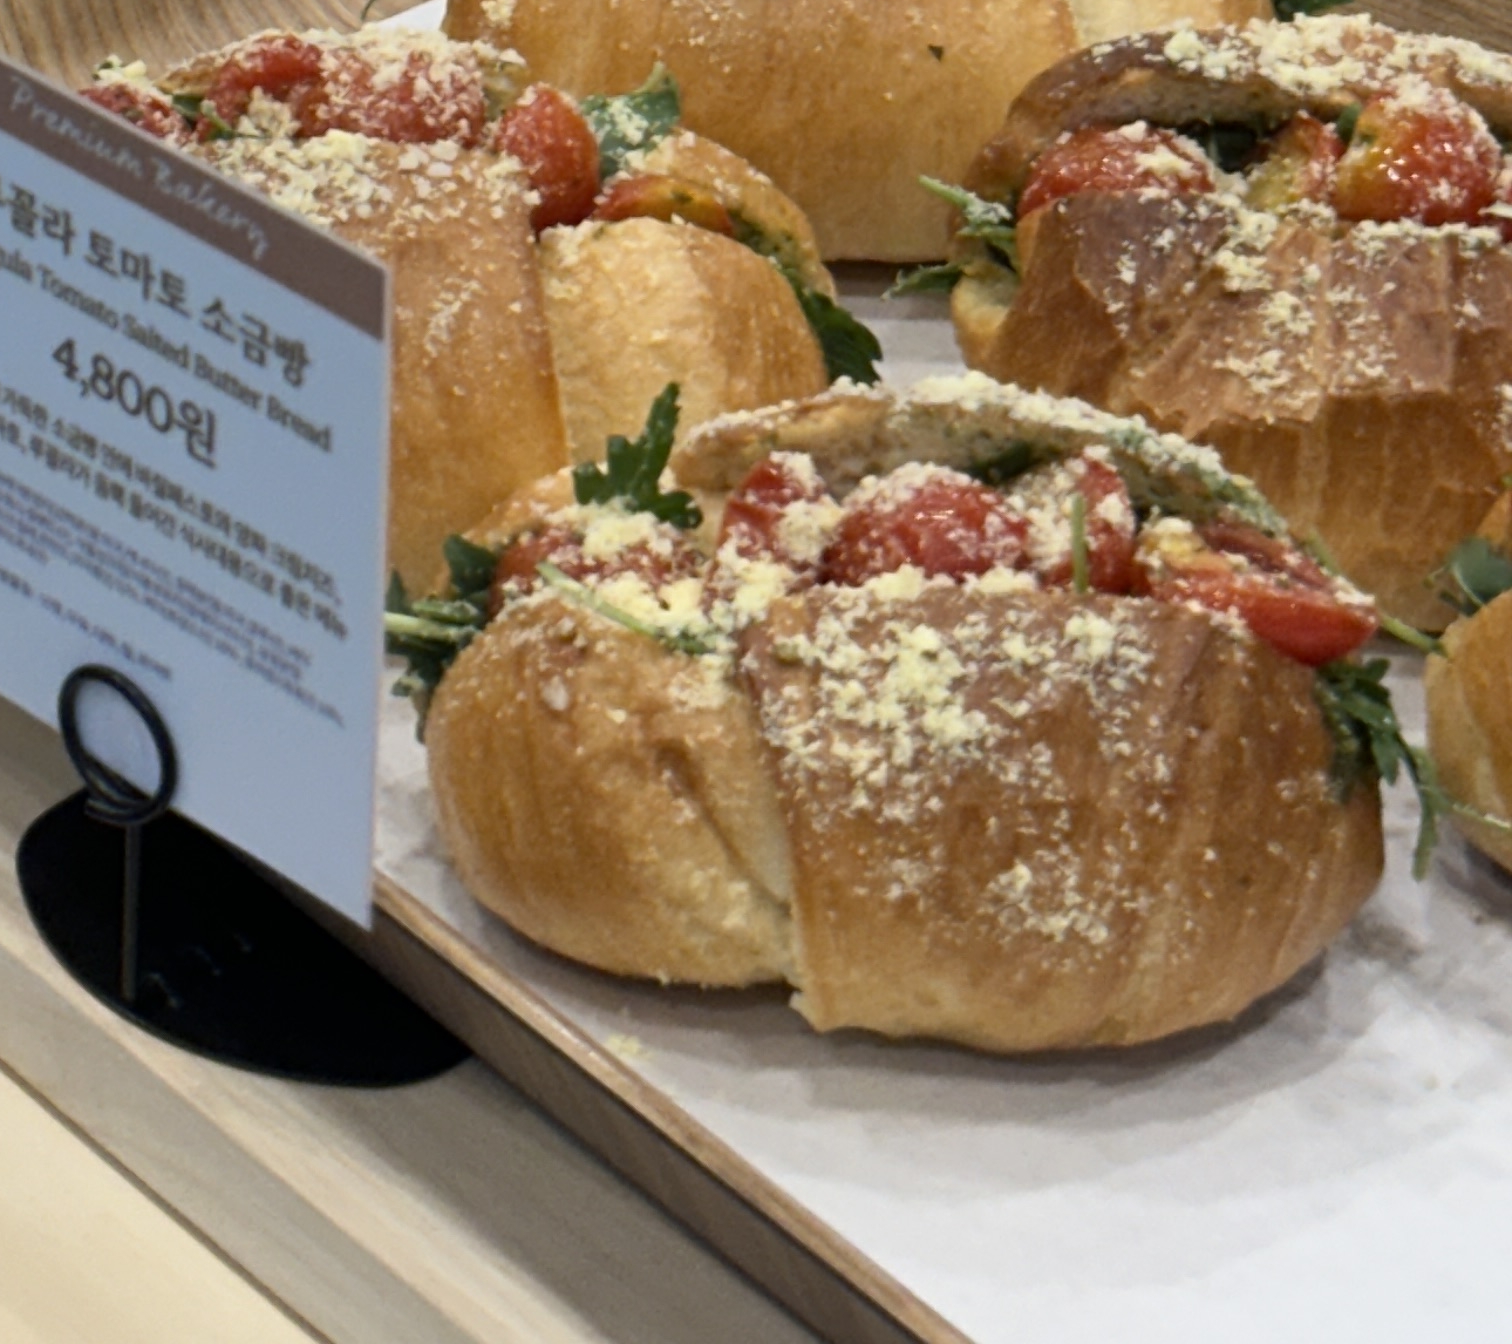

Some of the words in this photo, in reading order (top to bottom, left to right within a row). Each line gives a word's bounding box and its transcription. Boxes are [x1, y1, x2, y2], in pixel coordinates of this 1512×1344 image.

[10, 75, 142, 178] Premium
[151, 157, 268, 261] Bakery
[35, 263, 121, 331] Tomato
[121, 313, 191, 371] Salted
[193, 352, 264, 411] Butter
[265, 394, 333, 453] Bread
[84, 229, 191, 319] 토마토
[200, 297, 311, 389] 소금빵
[51, 337, 217, 470] 4,800원
